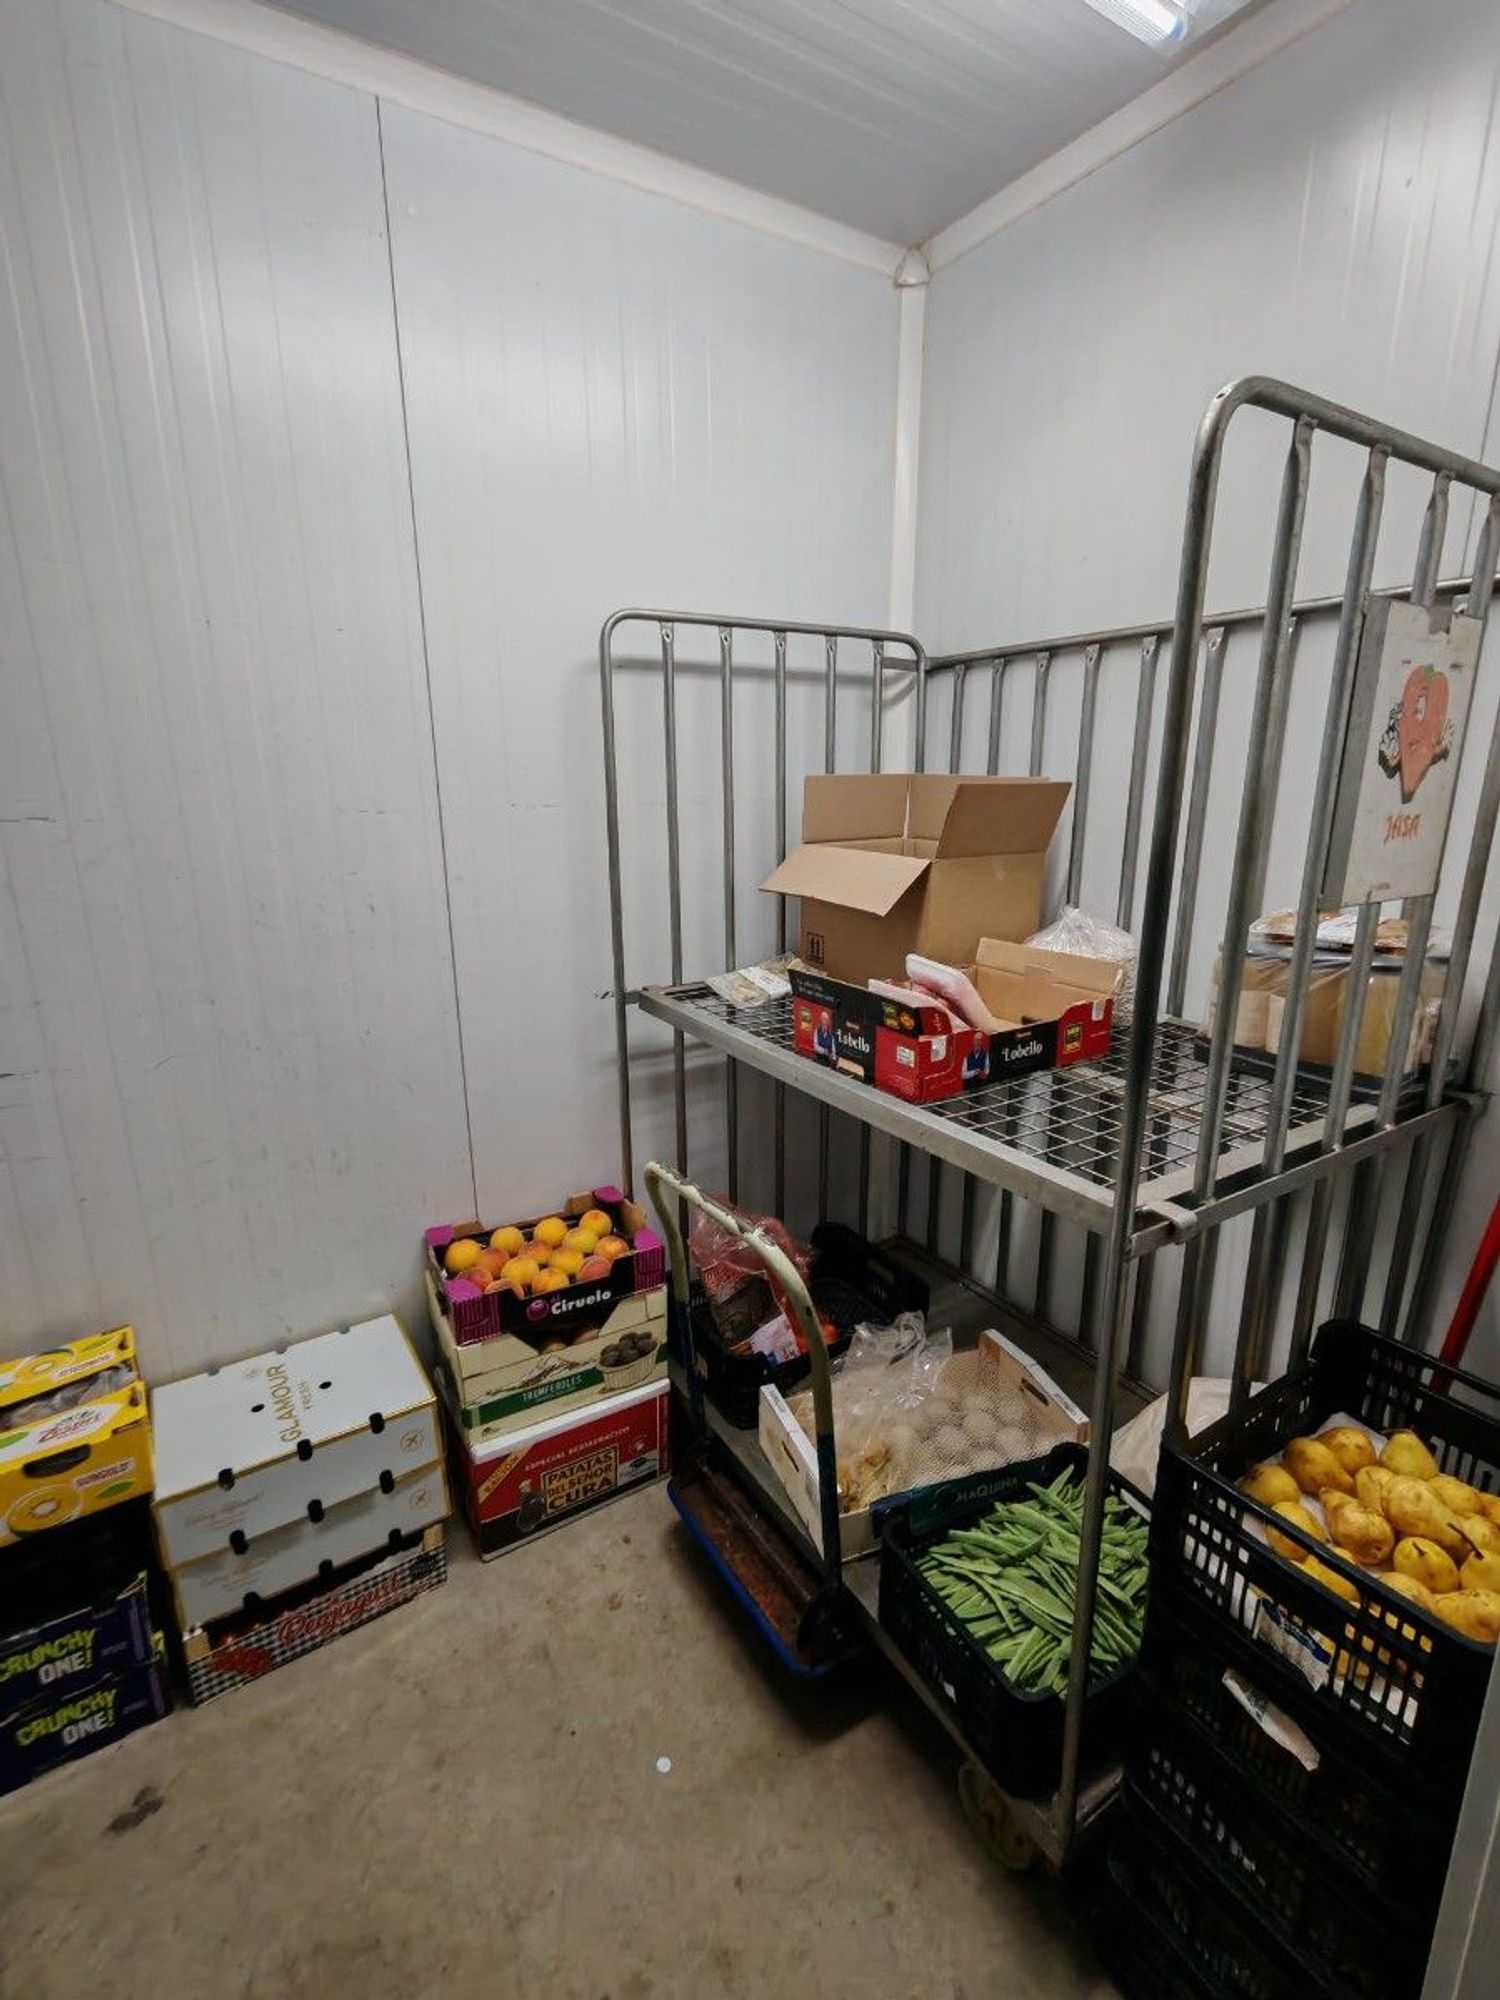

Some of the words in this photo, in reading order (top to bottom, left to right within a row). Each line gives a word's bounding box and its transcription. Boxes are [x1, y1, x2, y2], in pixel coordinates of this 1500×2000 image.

[551, 1289, 612, 1315] Ciruelo
[266, 1363, 302, 1441] GLAMOUR
[548, 1449, 613, 1486] PATATAS
[547, 1475, 612, 1511] CURA
[39, 1645, 93, 1685] ONE!
[15, 1689, 117, 1746] CRUNCHY
[62, 1708, 115, 1745] ONE!
